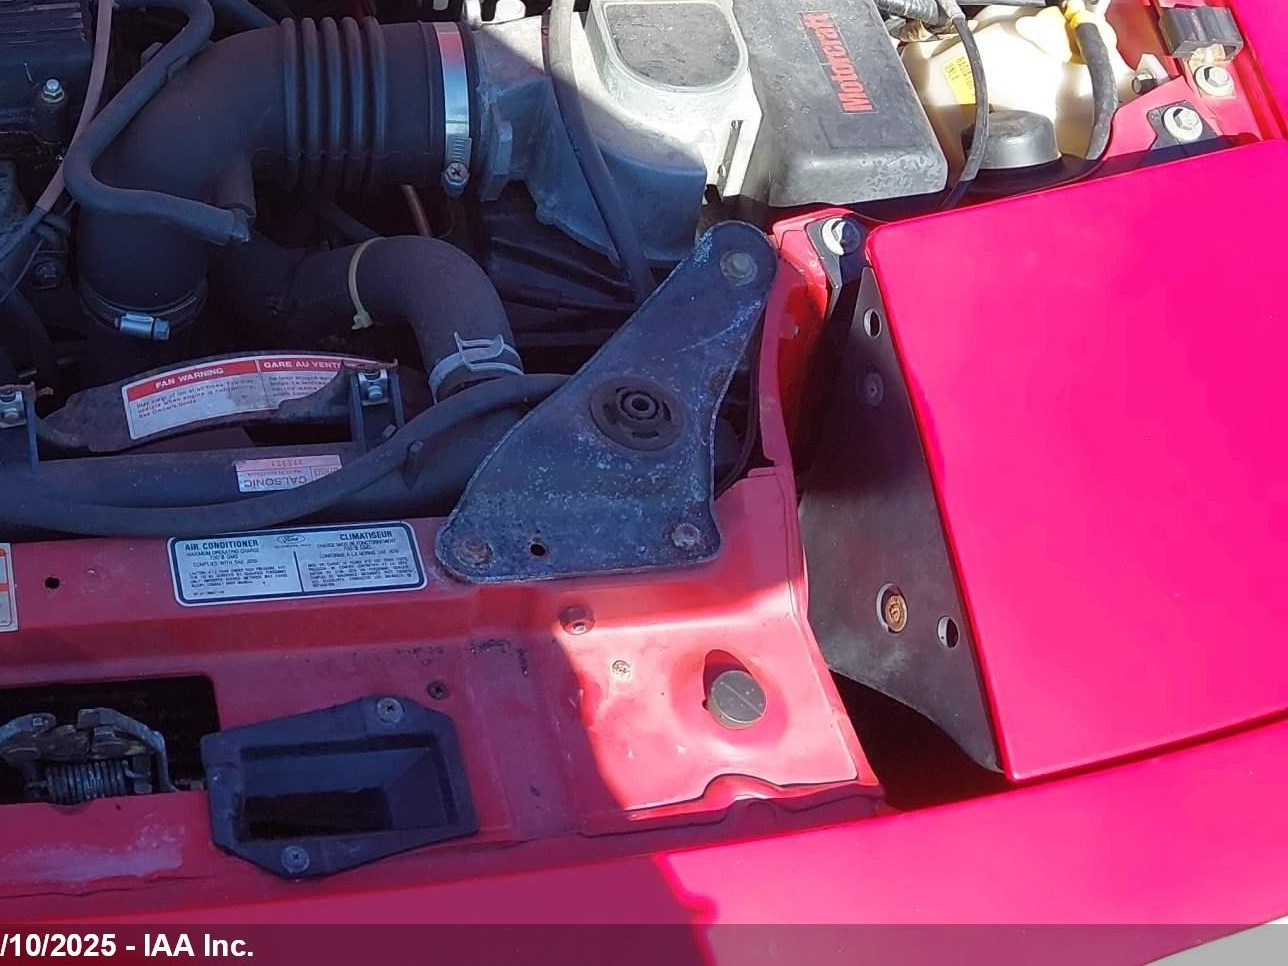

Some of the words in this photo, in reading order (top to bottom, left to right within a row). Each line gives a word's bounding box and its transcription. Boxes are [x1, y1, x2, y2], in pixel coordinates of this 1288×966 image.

[800, 11, 874, 112] Motorcraft
[263, 361, 292, 369] GARE
[295, 360, 309, 368] AU
[155, 377, 176, 389] FAN
[177, 367, 224, 382] WARNING
[243, 475, 308, 488] CALSONIC
[339, 530, 393, 541] CLIMATISEUR
[185, 543, 199, 551] AIR
[202, 539, 259, 550] CONDITIONER
